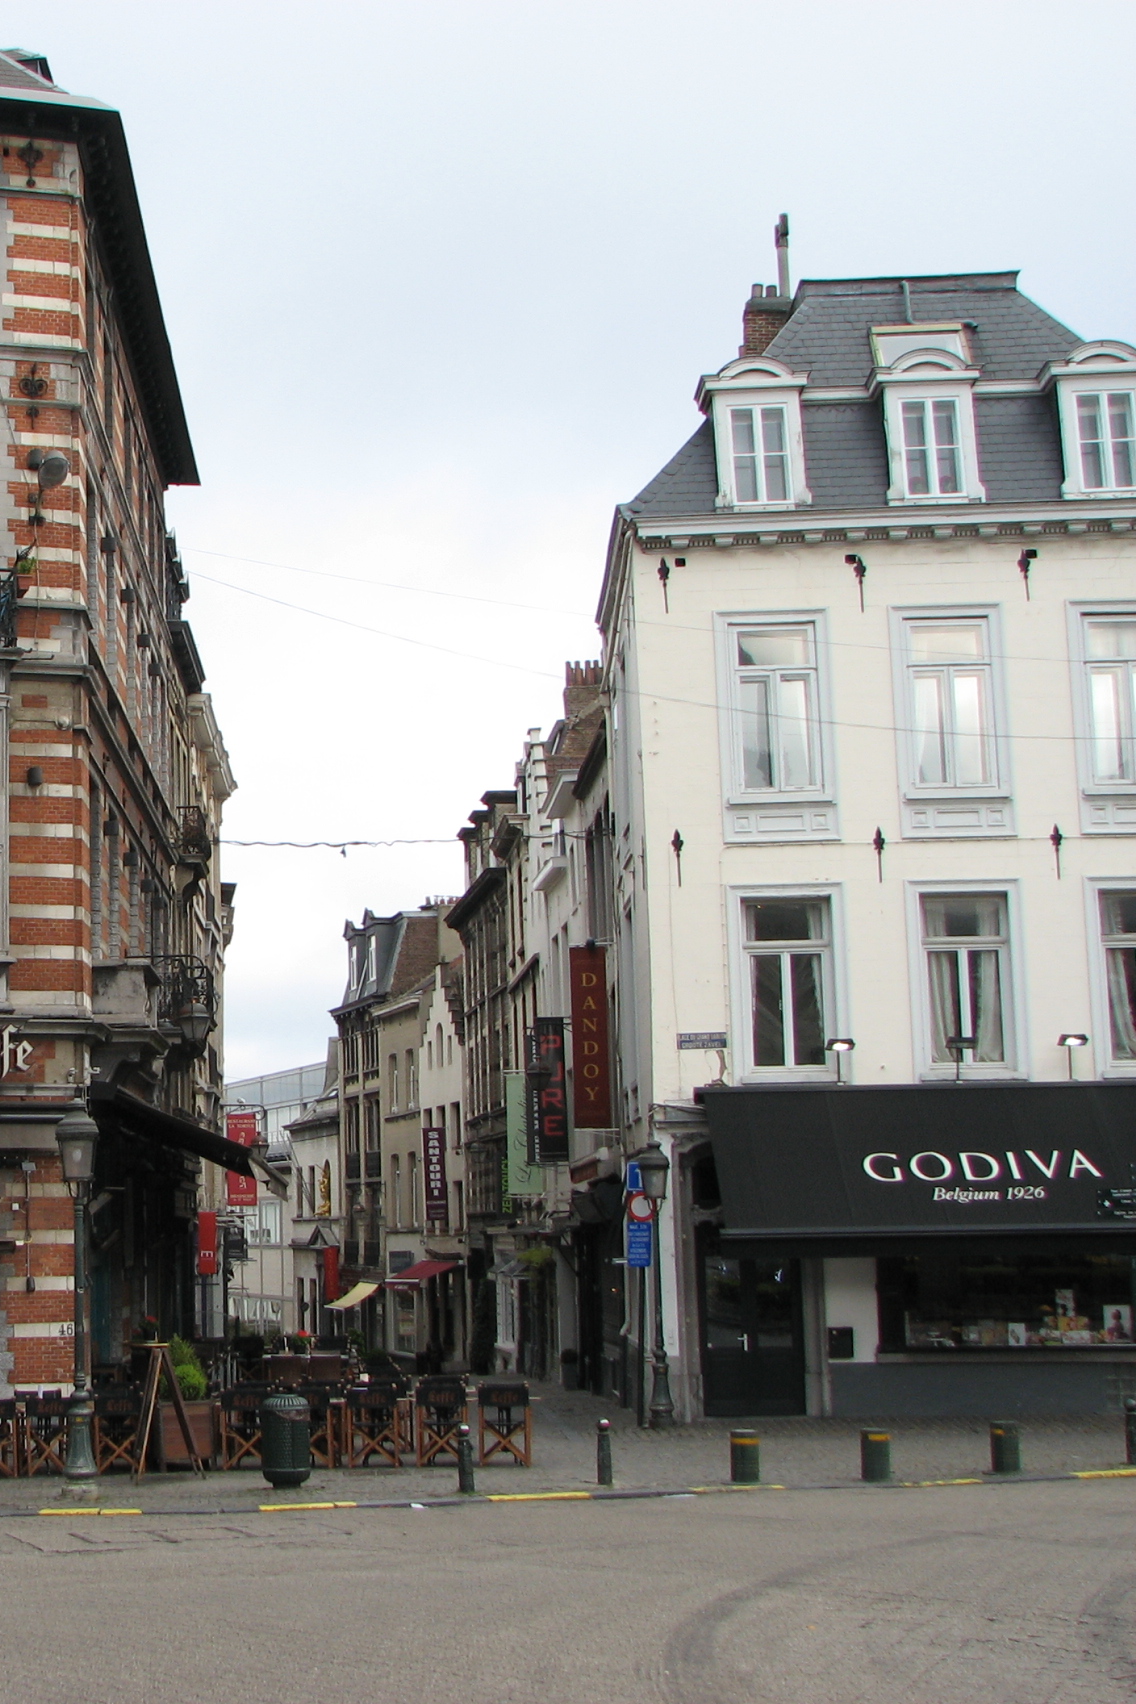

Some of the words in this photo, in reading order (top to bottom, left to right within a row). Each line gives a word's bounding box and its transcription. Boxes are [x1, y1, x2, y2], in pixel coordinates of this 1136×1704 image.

[581, 972, 599, 1101] DANDOY
[427, 1131, 441, 1197] SANTOURI
[862, 1148, 1103, 1182] GODIVA
[933, 1186, 1000, 1203] Belgium
[1006, 1186, 1046, 1200] 1926
[58, 1323, 74, 1336] 46
